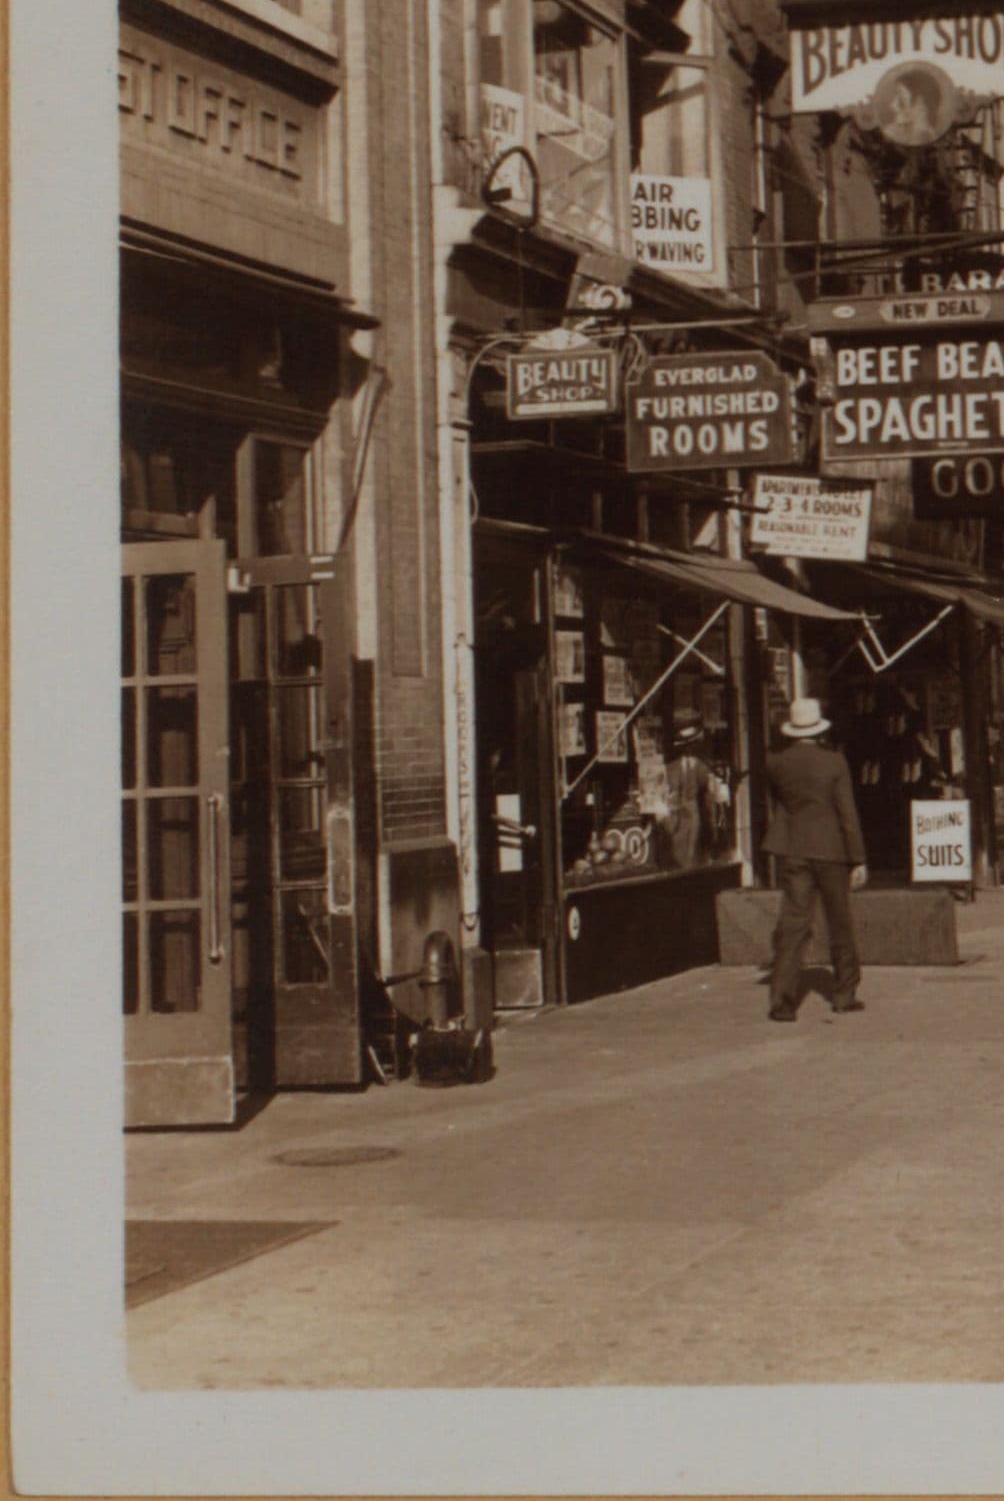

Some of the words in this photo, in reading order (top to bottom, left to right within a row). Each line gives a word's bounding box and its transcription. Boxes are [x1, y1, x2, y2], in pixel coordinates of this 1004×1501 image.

[801, 18, 926, 97] BEAUTY
[167, 68, 302, 182] OFFICE
[648, 241, 705, 265] WAVING
[893, 303, 929, 320] NEW
[937, 300, 981, 318] DEAL
[517, 358, 607, 397] BEAUTY
[654, 364, 757, 388] EVERGLAD
[837, 345, 922, 387] BEEF
[535, 386, 593, 401] SHOP
[636, 391, 779, 420] FURNISHED
[650, 419, 769, 457] ROOMS
[813, 499, 862, 518] ROOMS
[822, 524, 858, 538] RENT
[916, 843, 964, 867] SUITS
